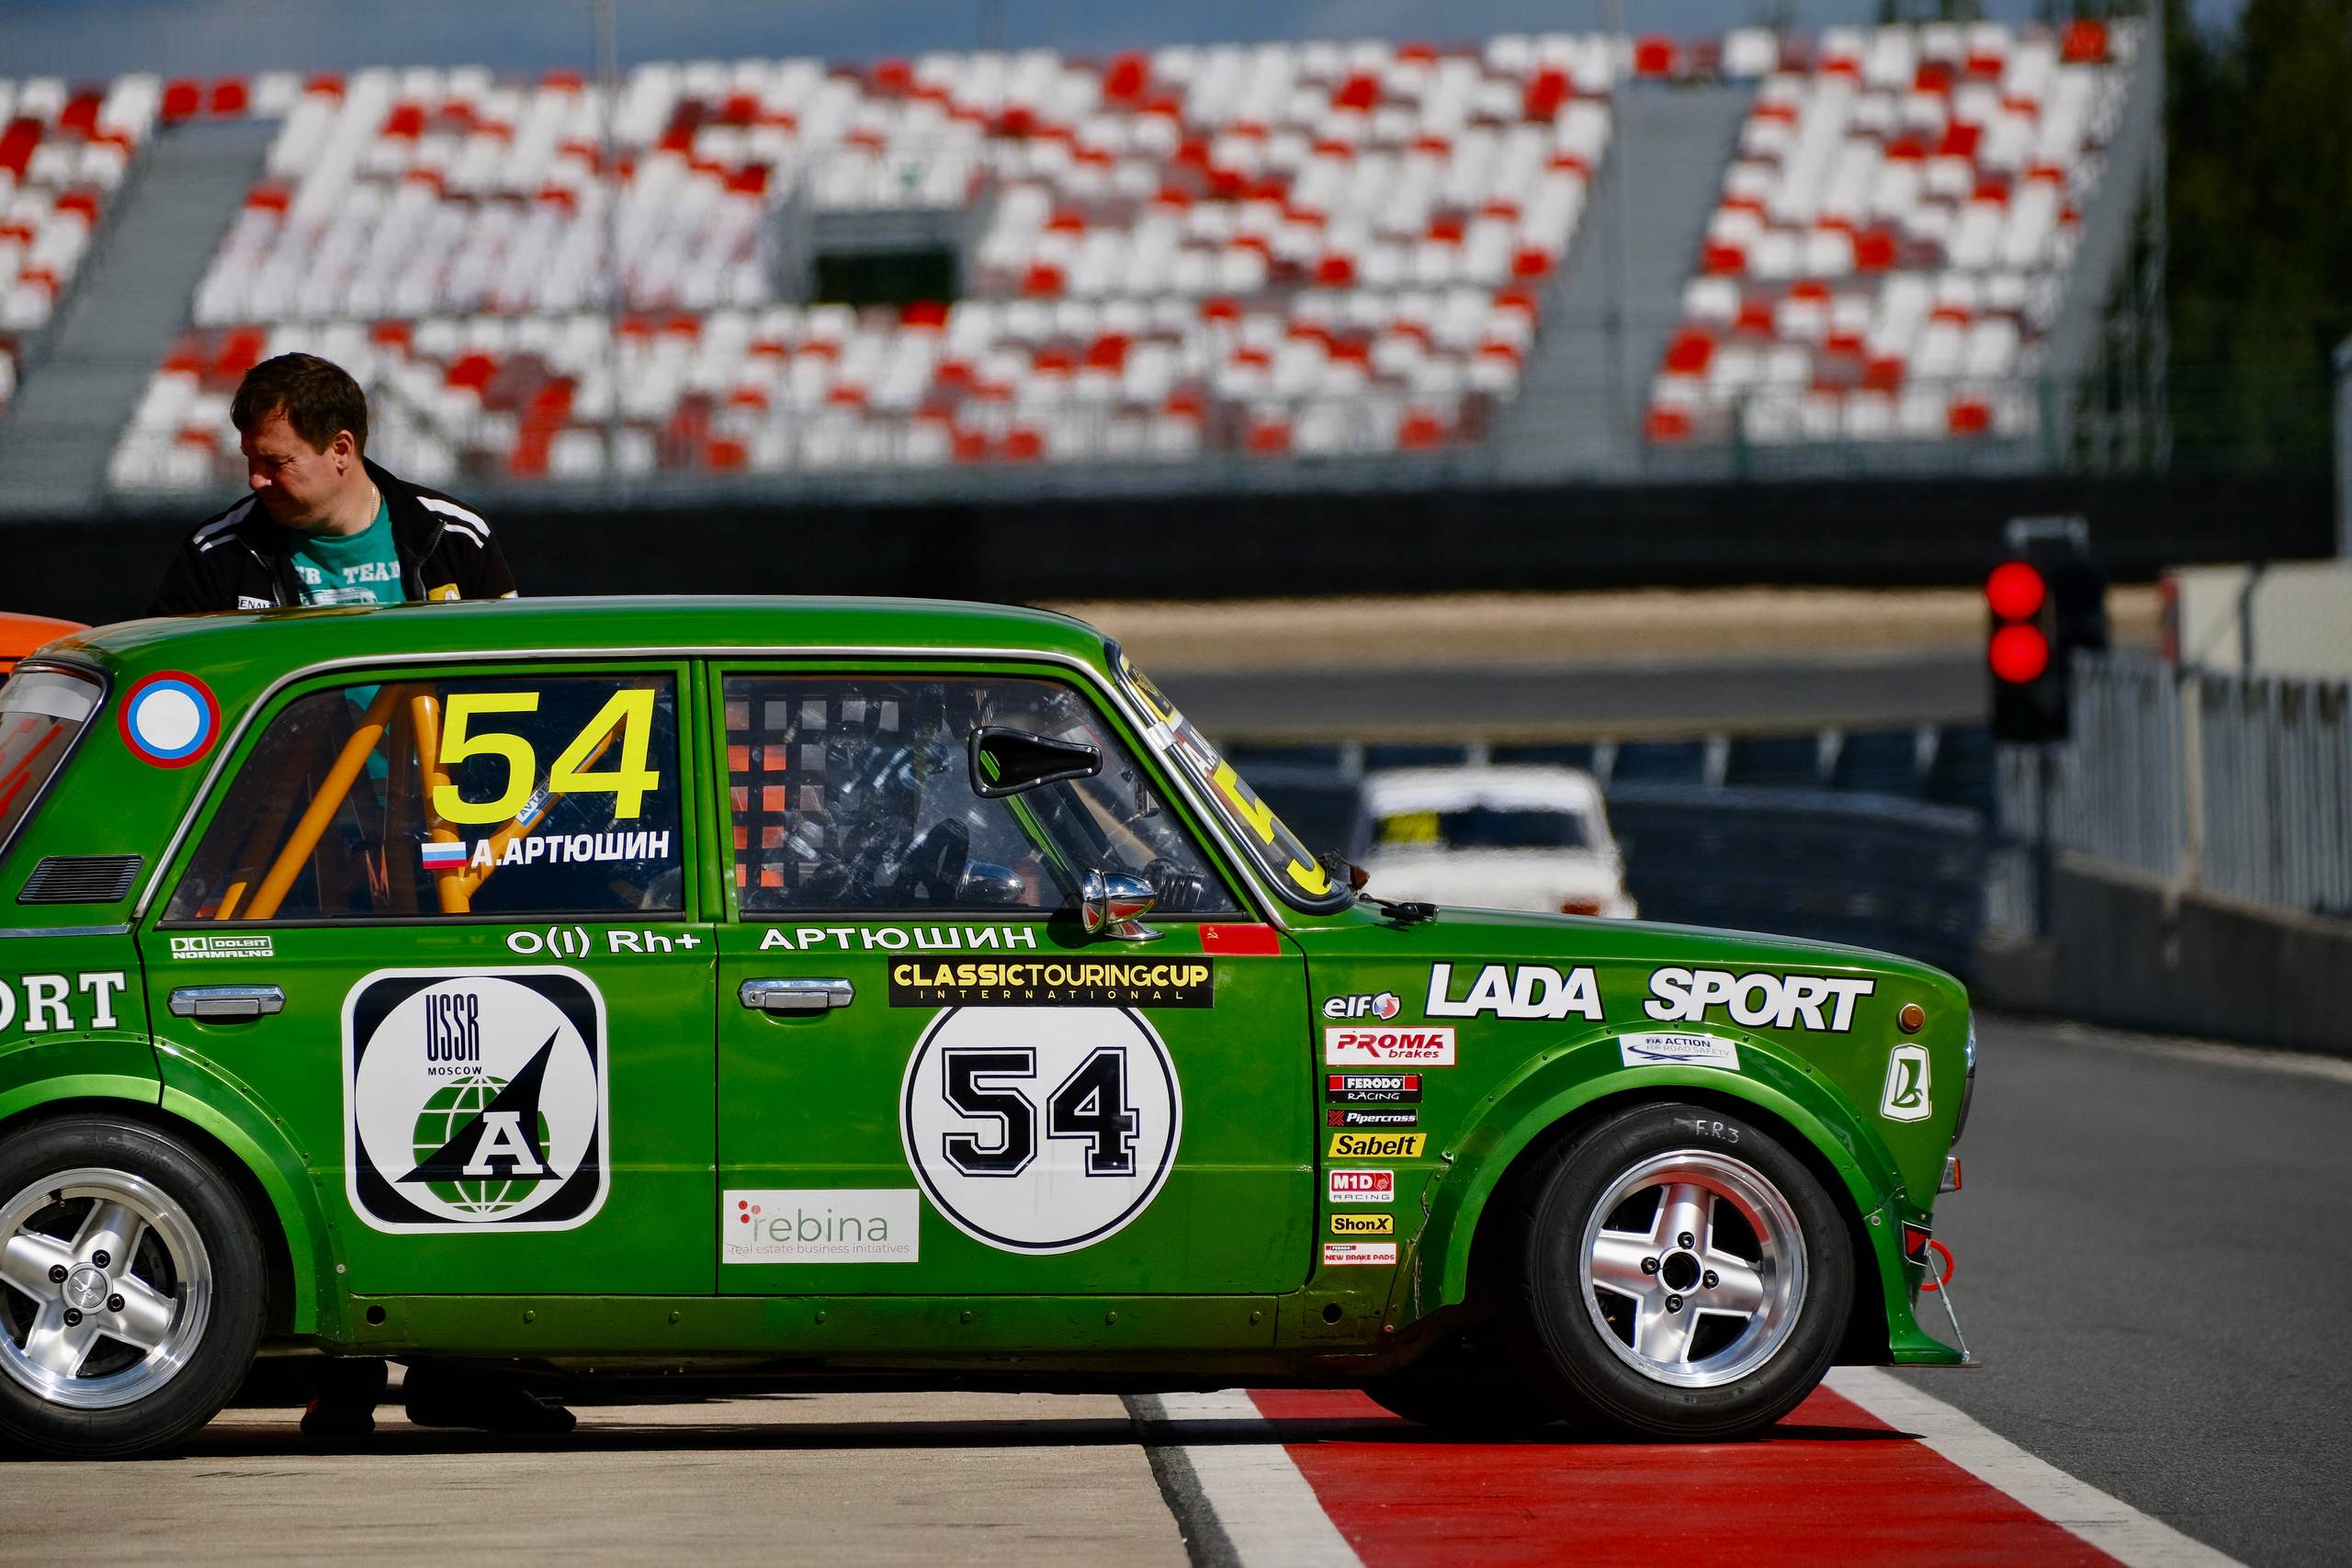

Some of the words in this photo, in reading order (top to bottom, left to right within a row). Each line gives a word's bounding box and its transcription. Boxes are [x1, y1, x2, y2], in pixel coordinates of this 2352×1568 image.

[433, 689, 660, 825] 54
[470, 830, 670, 867] А.АРТЮШИН
[214, 940, 267, 948] DOLBIT
[606, 929, 703, 953] Rh+
[758, 927, 1038, 951] АРТЮШИН
[920, 989, 1183, 1000] INTERNATIONAL
[1424, 962, 1606, 1021] LADA
[1643, 965, 1876, 1033] SPORT
[1323, 994, 1373, 1020] elf
[425, 993, 481, 1062] USSR
[1337, 1033, 1444, 1058] PROMA
[1665, 1037, 1712, 1048] ACTION
[1693, 1046, 1730, 1056] SAFETY
[1388, 1049, 1440, 1058] brakes
[427, 1066, 483, 1077] MOSCOW
[1347, 1077, 1402, 1090] FERODO
[1347, 1091, 1401, 1101] RACING
[942, 1045, 1140, 1179] 54
[1346, 1112, 1417, 1125] Pipercross
[462, 1111, 545, 1176] A
[1336, 1134, 1417, 1156] Sabelt
[1333, 1175, 1374, 1190] M1D
[753, 1208, 888, 1243] rebina
[1334, 1217, 1390, 1230] ShonX
[730, 1244, 752, 1255] real
[756, 1245, 794, 1254] estate
[797, 1244, 850, 1254] business
[853, 1243, 910, 1254] initiatives
